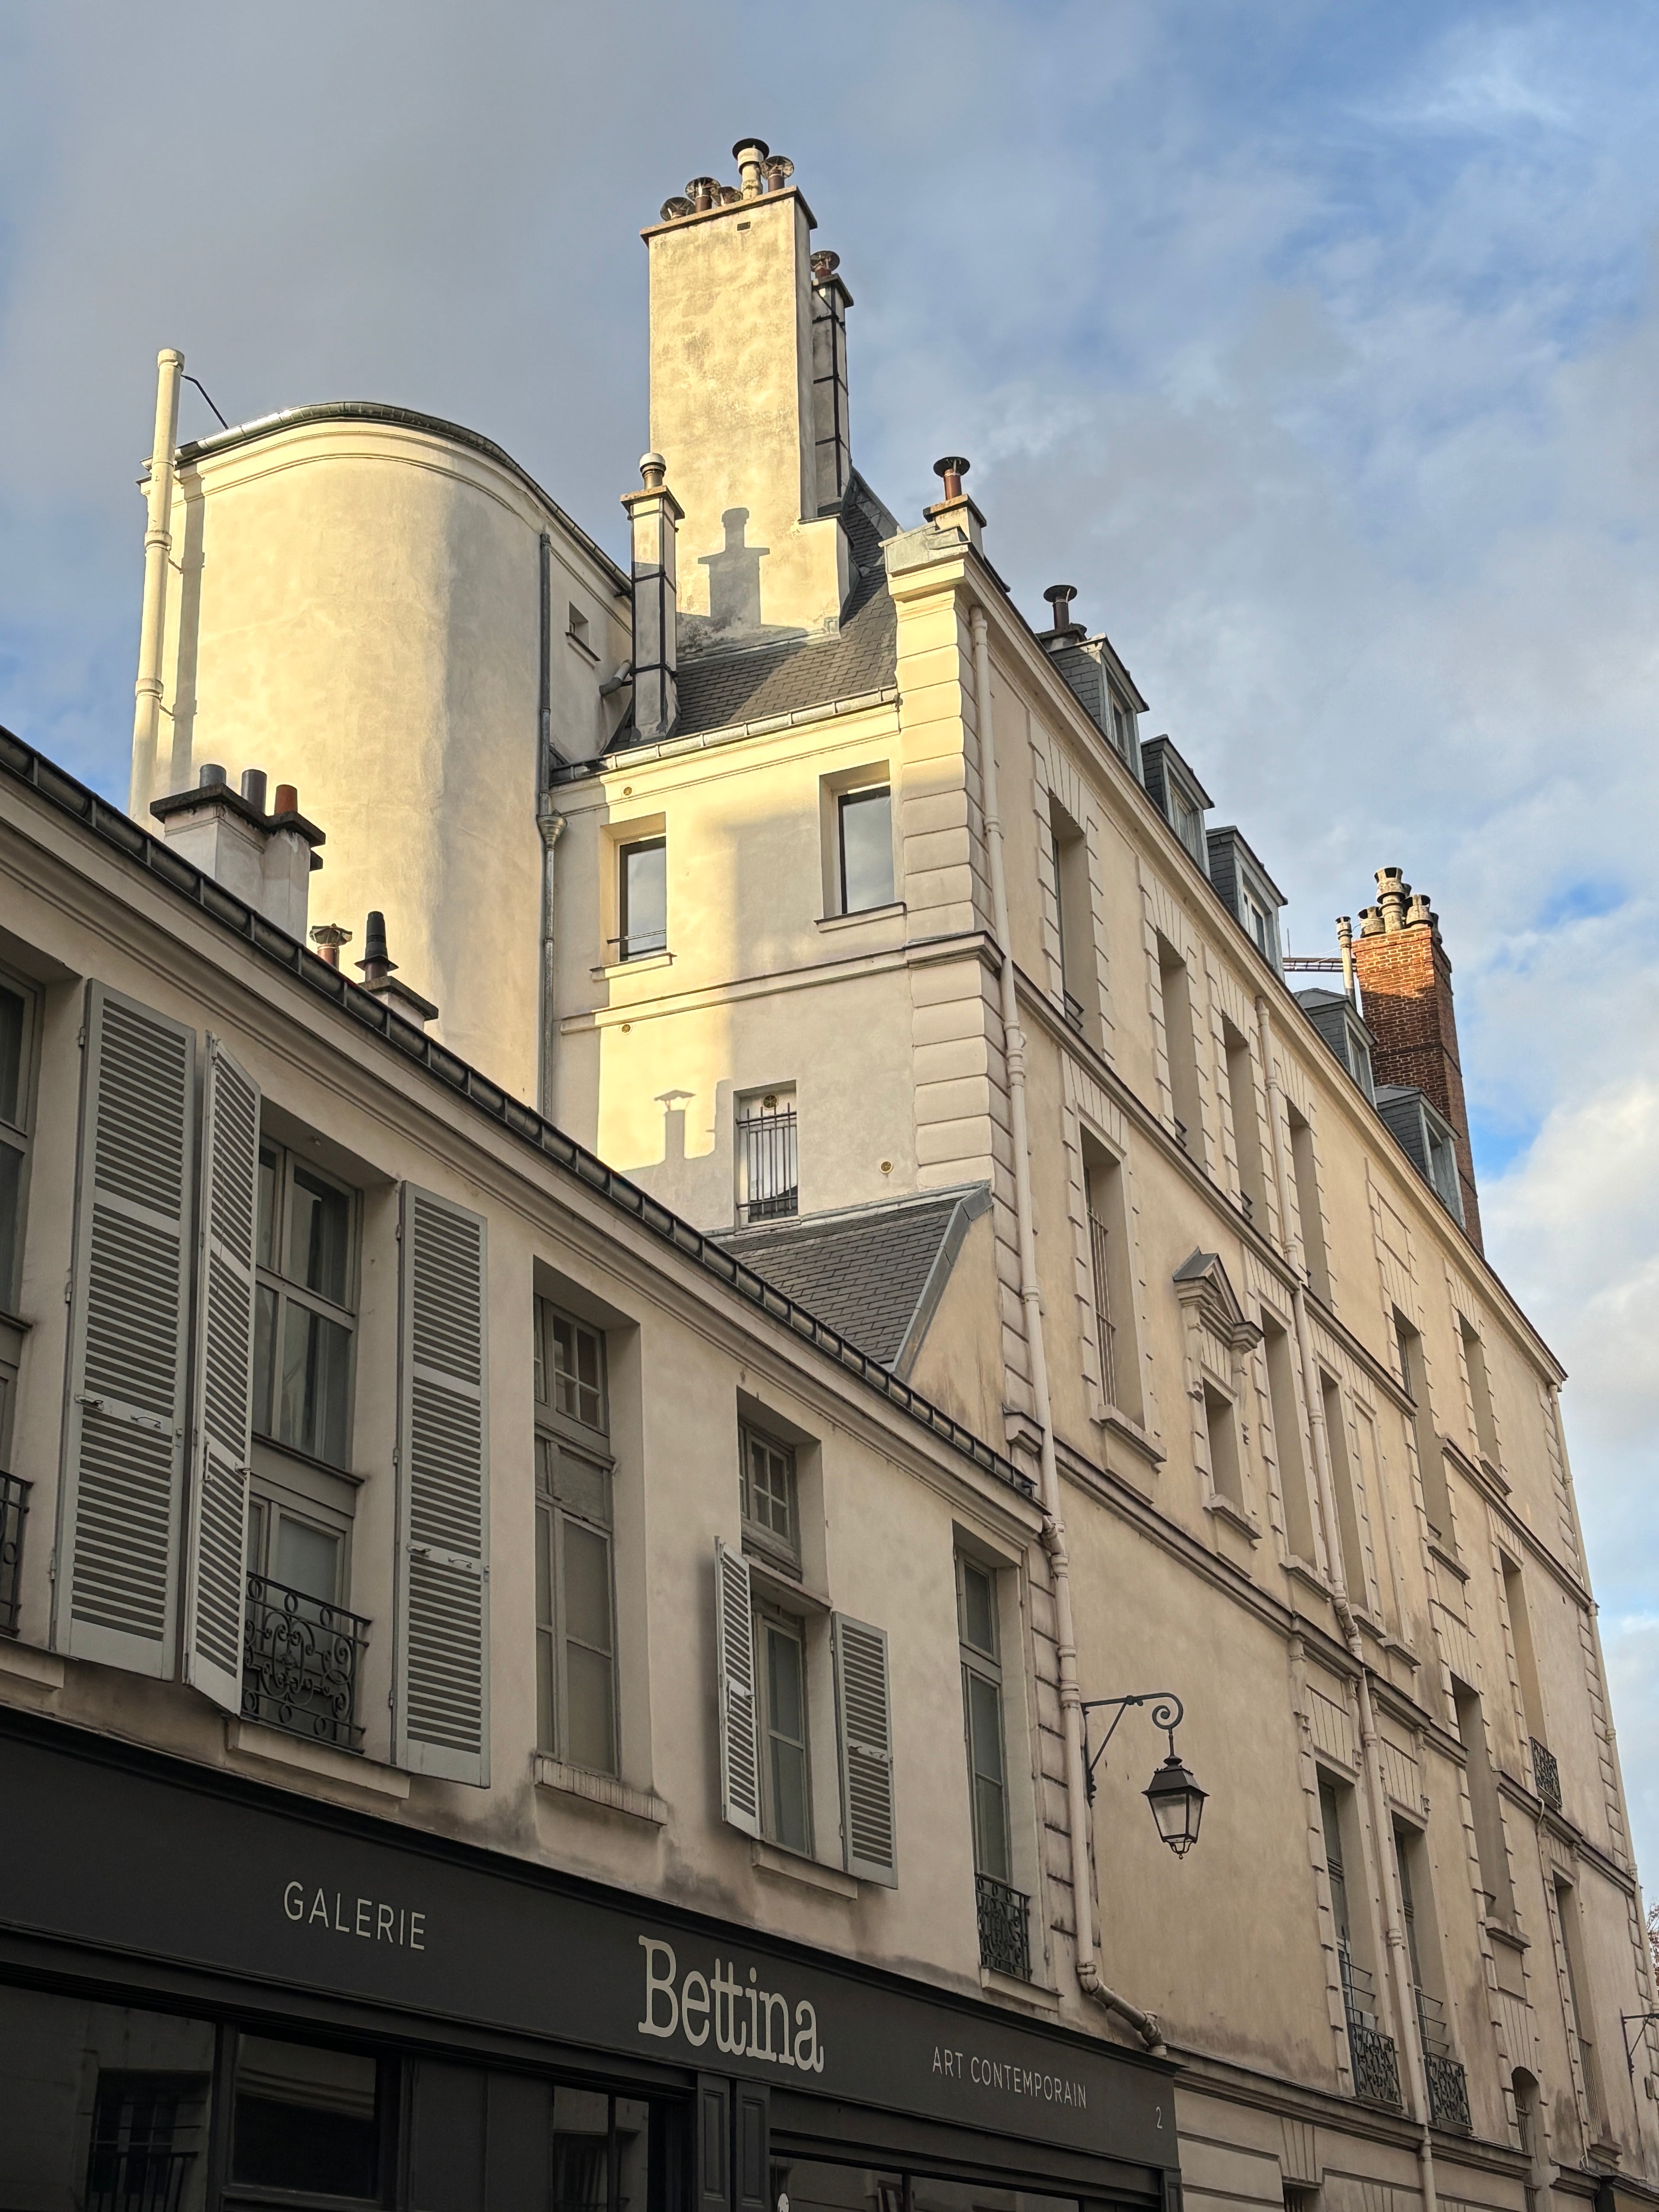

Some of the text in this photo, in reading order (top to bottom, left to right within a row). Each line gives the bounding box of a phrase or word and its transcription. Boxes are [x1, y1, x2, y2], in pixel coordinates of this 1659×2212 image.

[283, 1881, 426, 1950] GALERIE
[638, 1935, 824, 2073] Bettina
[932, 2046, 1087, 2109] ART CONTEMPORAIN
[1155, 2106, 1163, 2129] 2
